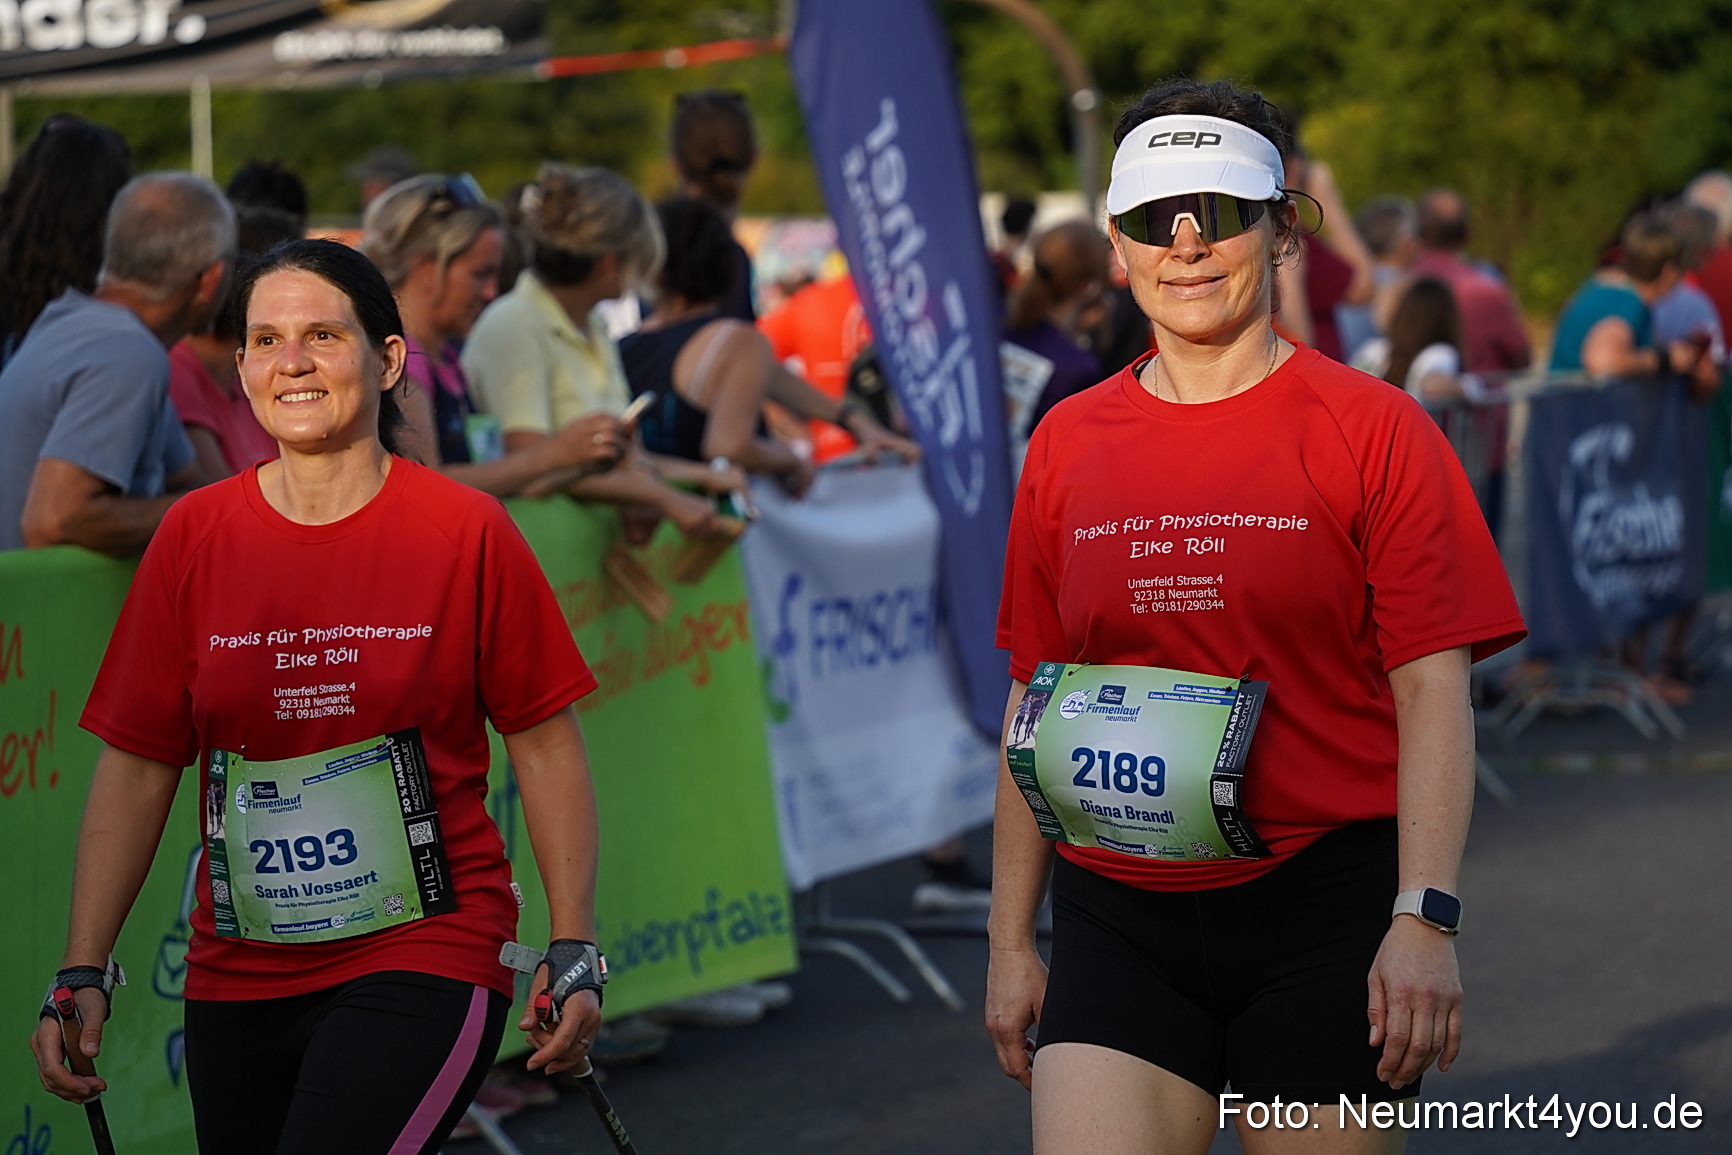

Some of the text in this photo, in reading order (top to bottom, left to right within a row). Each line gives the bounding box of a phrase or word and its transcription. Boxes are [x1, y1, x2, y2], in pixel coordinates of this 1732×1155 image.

[1147, 131, 1222, 149] cep
[1073, 512, 1309, 545] Praxis für Physiotherapie
[1129, 536, 1225, 559] Elke Röll
[1127, 574, 1224, 589] Unterfeld Strasse.4
[1133, 587, 1218, 601] 92318 Neumarkt
[1130, 599, 1225, 614] Tel: 09181/290344
[209, 623, 433, 651] Praxis für Physiotherapie
[275, 647, 359, 670] Elke Röll
[273, 682, 356, 698] Unterfeld Strasse.4
[1032, 676, 1055, 686] AOK
[274, 705, 356, 720] Tel: 09181/290344
[279, 694, 350, 709] 92318 Neumarkt
[1086, 703, 1141, 715] Firmenlauf
[1217, 692, 1245, 768] 20 % RABATT
[1226, 729, 1241, 768] FACTORY
[1239, 693, 1253, 728] OUTLET
[210, 763, 225, 775] AOK
[401, 742, 413, 774] OUTLET
[391, 745, 412, 813] 20 % RABATT
[1071, 746, 1166, 797] 2189
[247, 793, 302, 809] Firmenlauf
[408, 775, 421, 811] FACTORY
[268, 803, 303, 814] neumarkt
[1079, 799, 1122, 820] Diana
[1125, 804, 1176, 826] Brandl
[1223, 811, 1251, 852] HILTL
[250, 828, 358, 874] 2193
[254, 870, 379, 900] Sarah Vossaert
[419, 849, 439, 902] HILTL
[563, 960, 588, 984] LEKI
